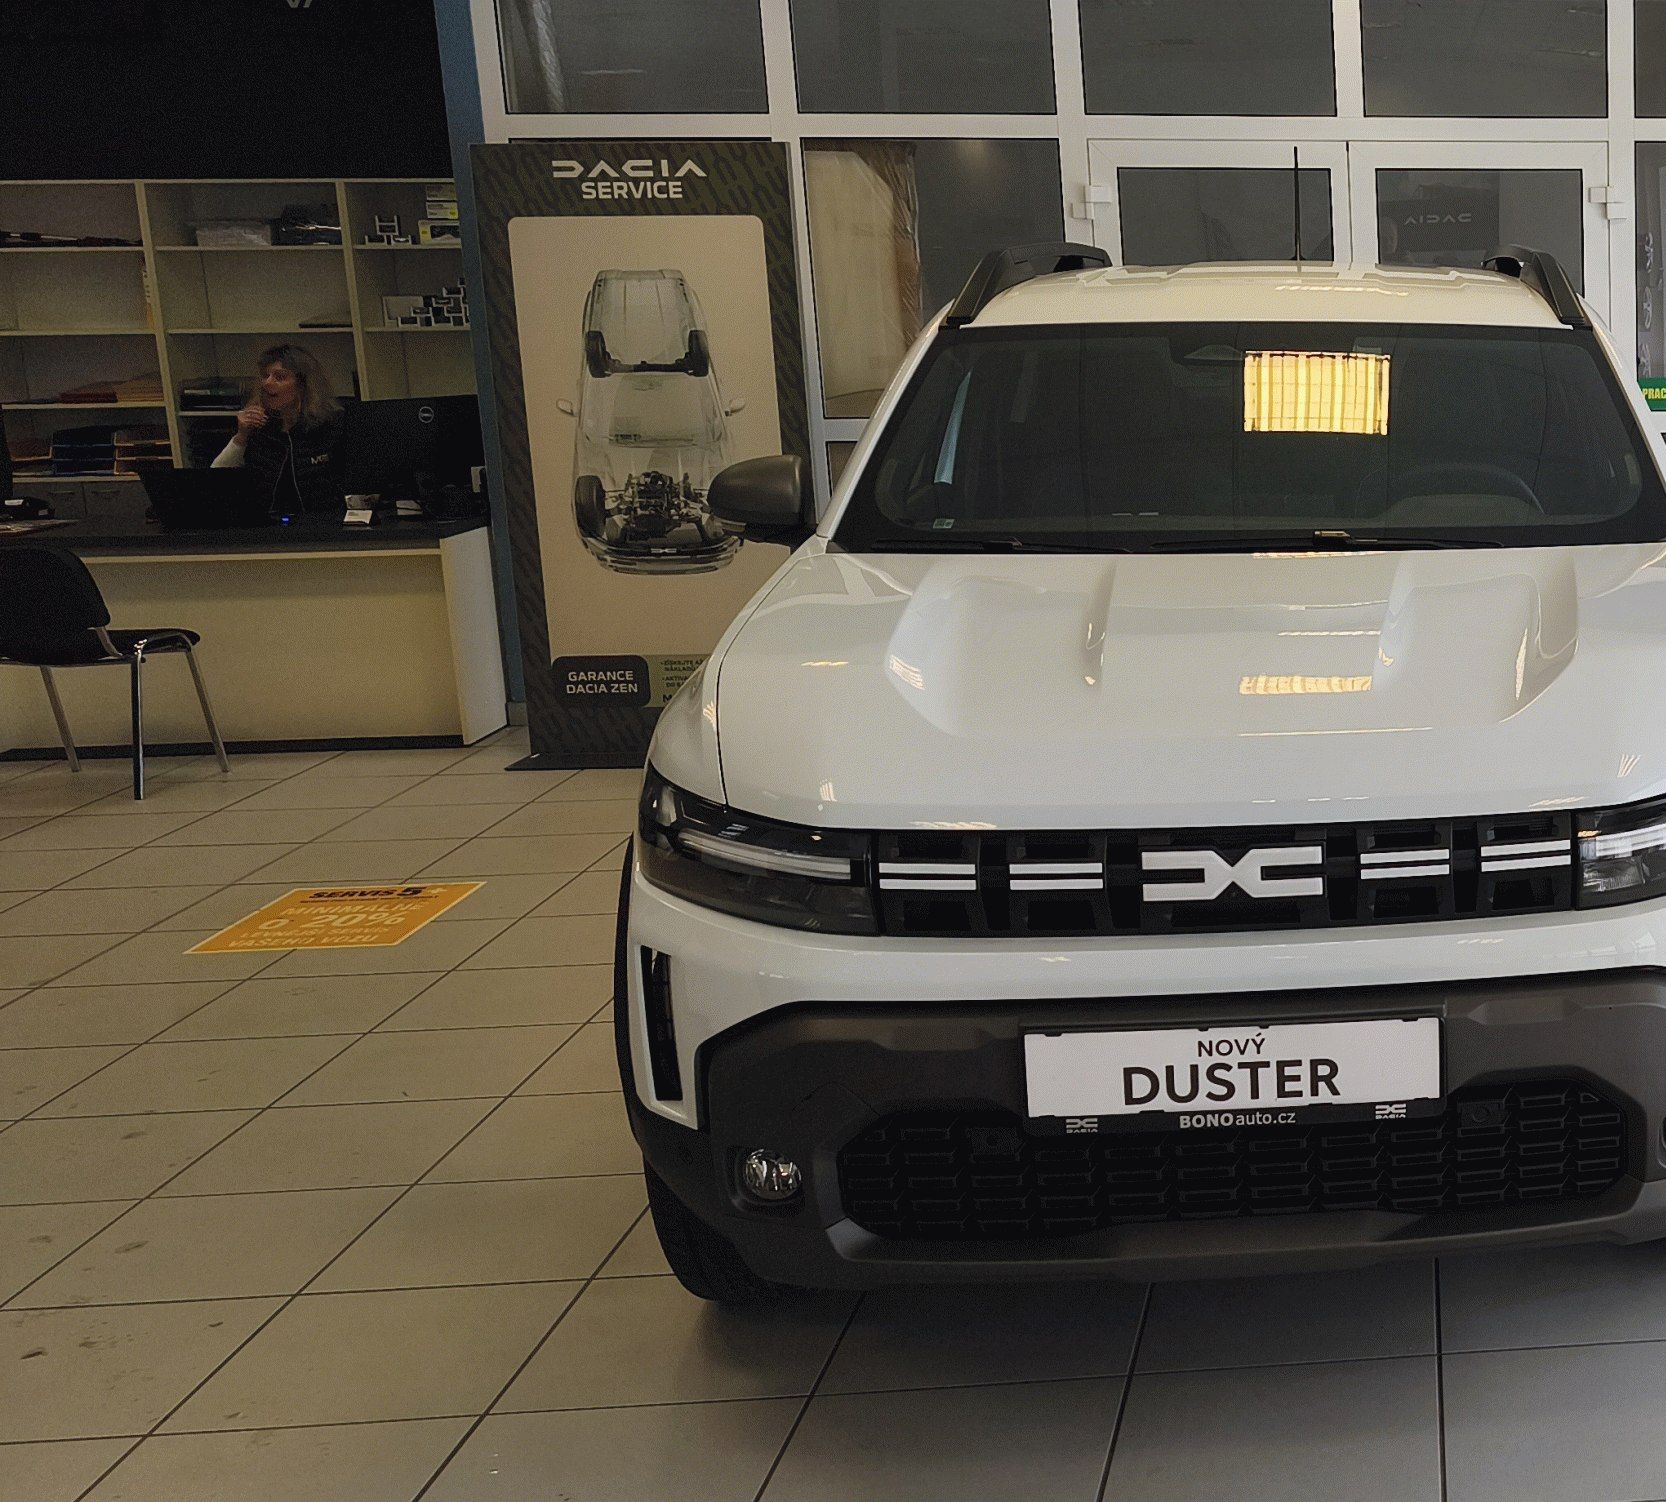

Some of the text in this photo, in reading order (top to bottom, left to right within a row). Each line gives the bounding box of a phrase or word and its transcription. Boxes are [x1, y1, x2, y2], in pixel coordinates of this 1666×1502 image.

[552, 159, 708, 178] DACIA
[581, 181, 683, 199] SERVICE
[568, 670, 634, 682] GARANCE
[566, 683, 638, 694] DACIA ZEN
[309, 888, 397, 899] SERVIS
[300, 911, 408, 928] 20%
[1197, 1033, 1266, 1058] NOVÝ
[1123, 1058, 1341, 1106] DUSTER
[1179, 1110, 1296, 1129] BONOauto.cz
